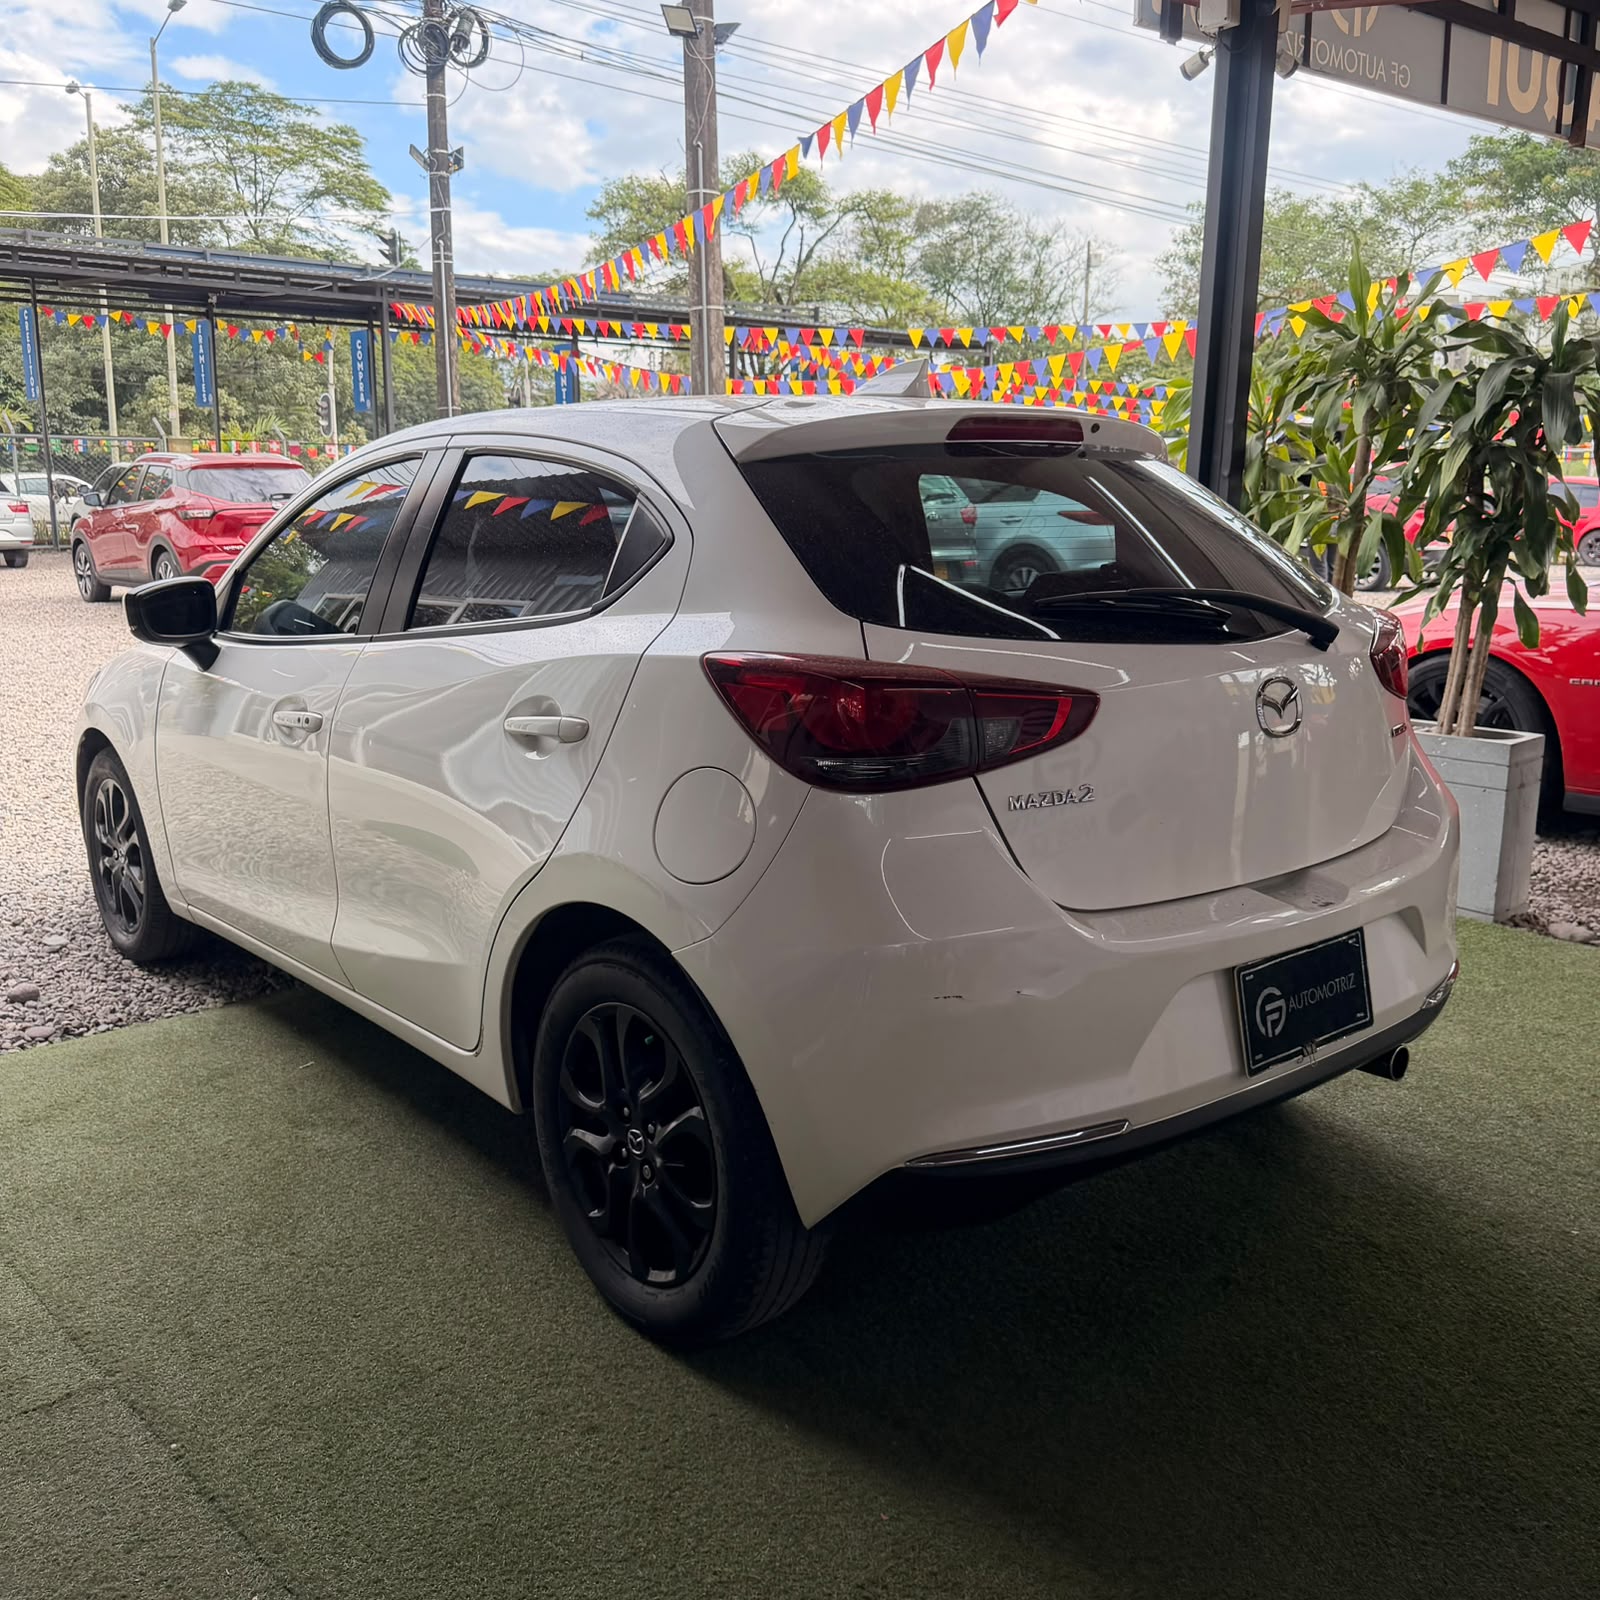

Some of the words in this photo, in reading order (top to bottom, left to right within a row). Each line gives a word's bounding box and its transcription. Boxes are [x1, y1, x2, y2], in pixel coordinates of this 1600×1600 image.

[198, 324, 207, 402] TRAMITES
[356, 339, 365, 403] COMPRA
[1008, 783, 1095, 811] MAZDA2
[1288, 972, 1357, 1013] AUTOMOTRIZ
